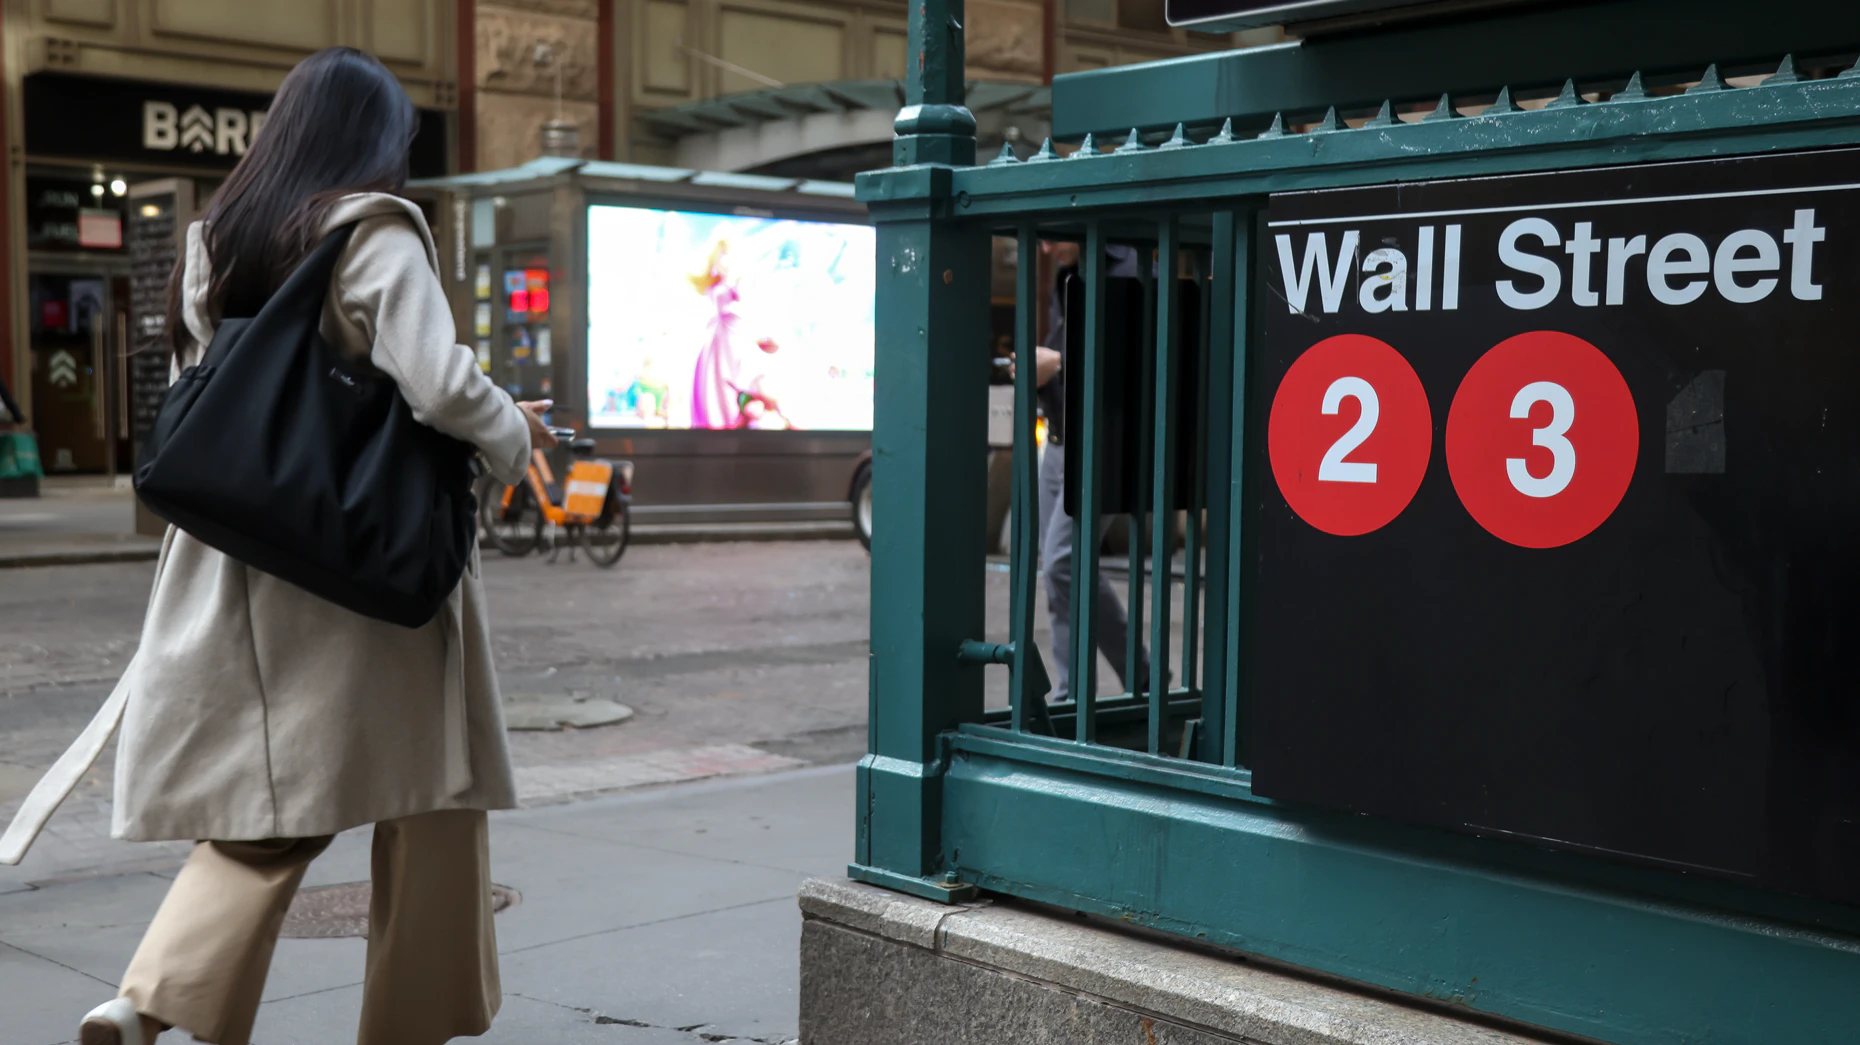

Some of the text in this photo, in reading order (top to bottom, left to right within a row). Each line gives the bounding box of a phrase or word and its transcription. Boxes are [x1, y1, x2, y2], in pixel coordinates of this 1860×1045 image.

[1275, 208, 1826, 315] Wall Street
[1318, 376, 1576, 498] 2 3
